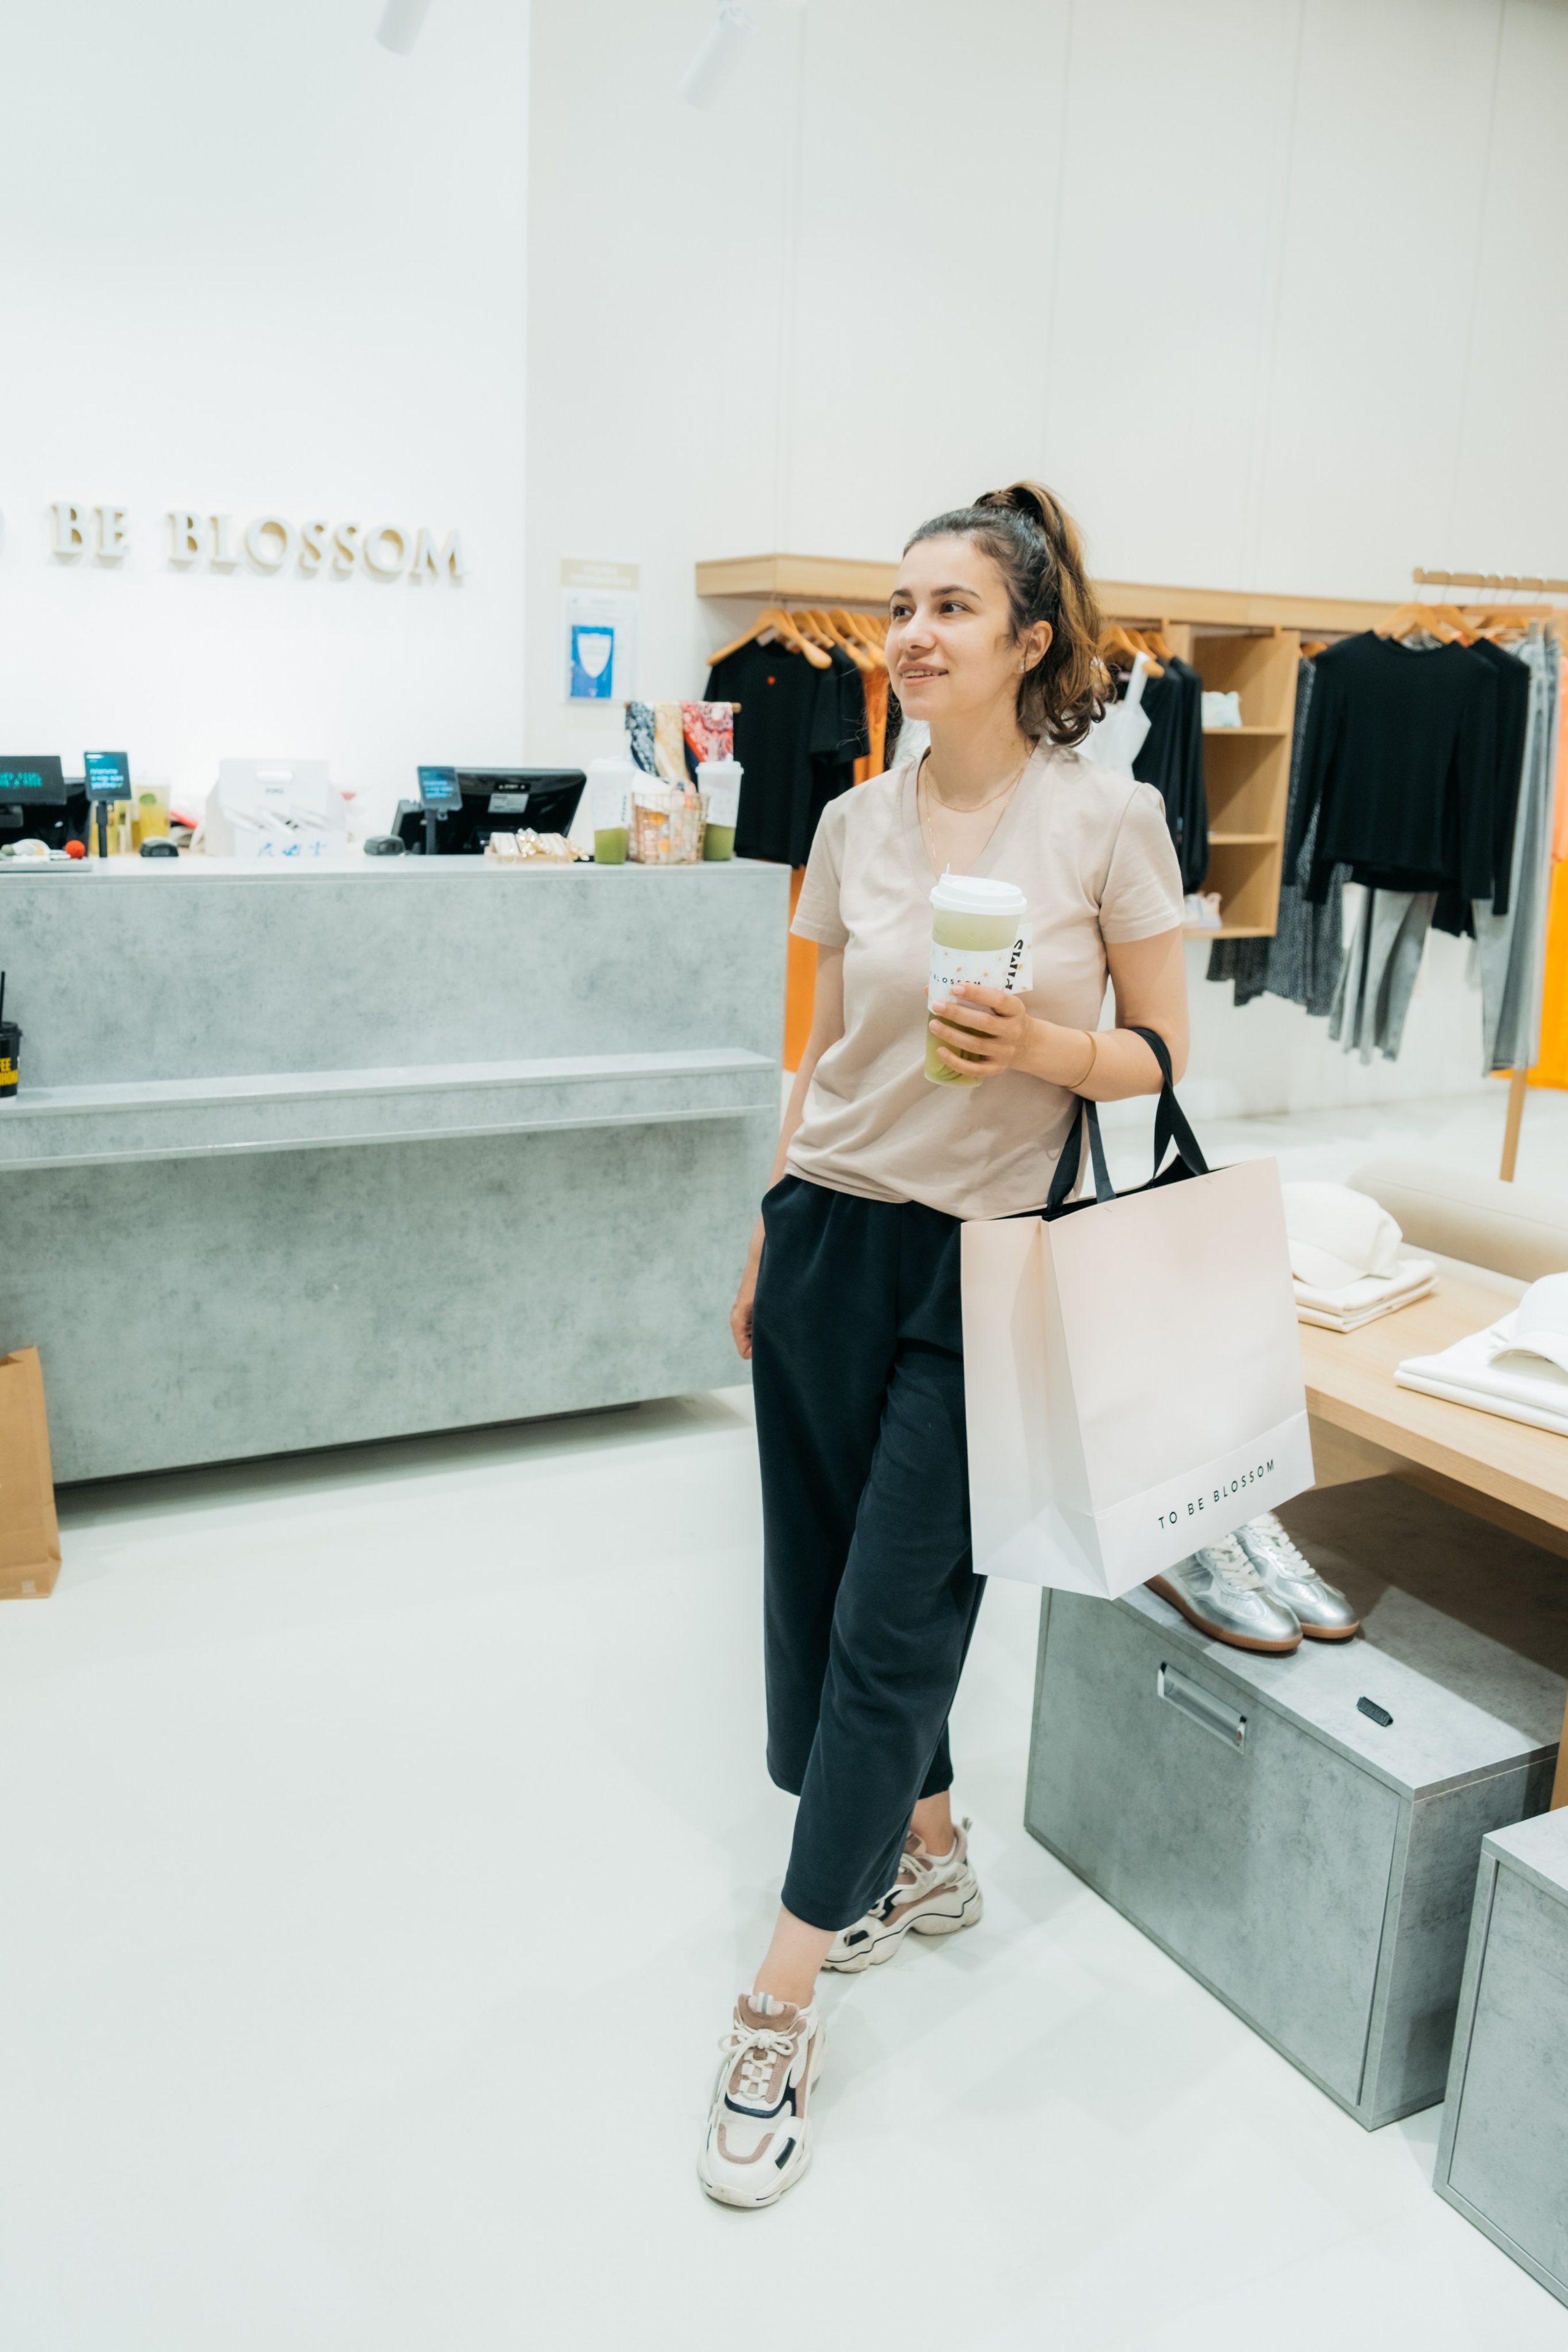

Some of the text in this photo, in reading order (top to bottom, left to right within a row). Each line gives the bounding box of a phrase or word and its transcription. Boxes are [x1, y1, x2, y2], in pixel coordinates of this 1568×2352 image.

[48, 502, 130, 560] BE
[165, 509, 467, 578] BLOSSOM
[933, 974, 981, 985] BLOSM
[1158, 1459, 1274, 1529] TO BE BLOSSOM
